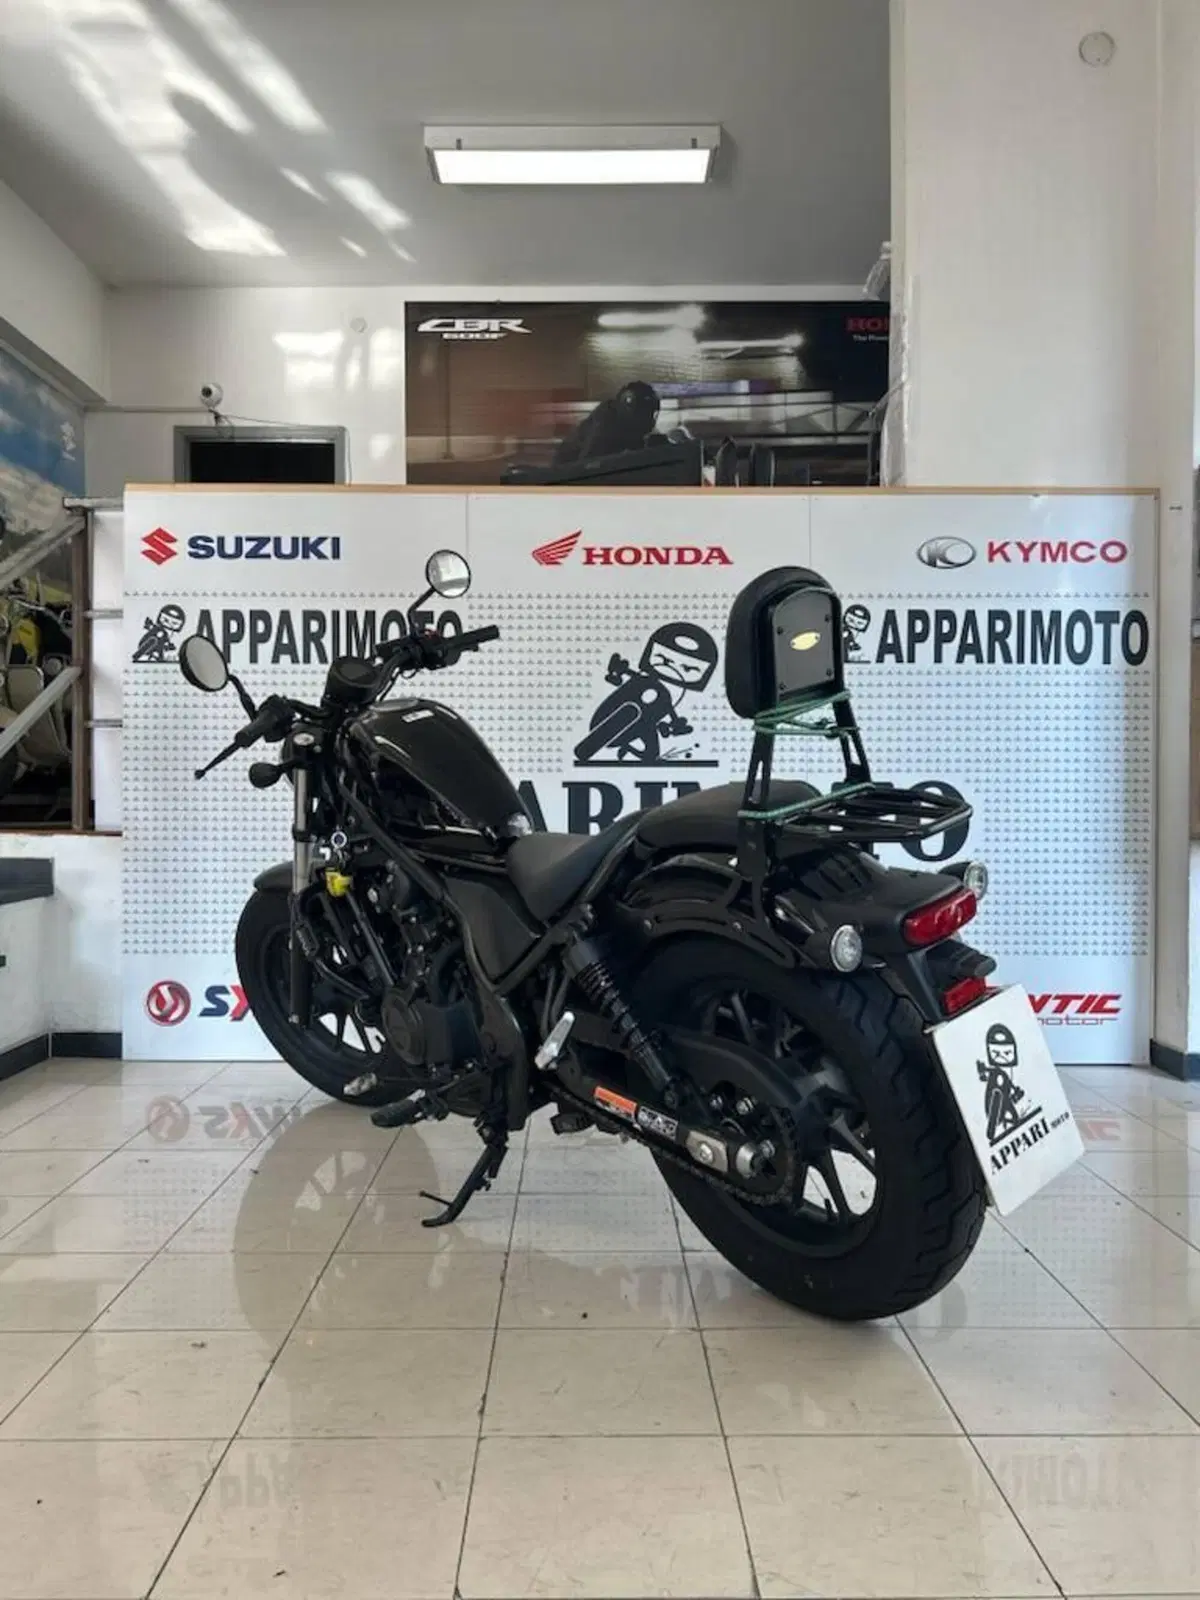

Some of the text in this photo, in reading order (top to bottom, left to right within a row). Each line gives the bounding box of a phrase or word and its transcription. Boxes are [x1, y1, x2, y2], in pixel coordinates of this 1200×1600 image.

[417, 318, 532, 333] CBR
[847, 317, 889, 331] HO
[187, 536, 341, 560] SUZUKI
[582, 546, 734, 565] HONDA
[987, 540, 1128, 563] KYMCO
[876, 609, 1149, 666] APPARIMOTO
[990, 1117, 1050, 1175] APPARI
